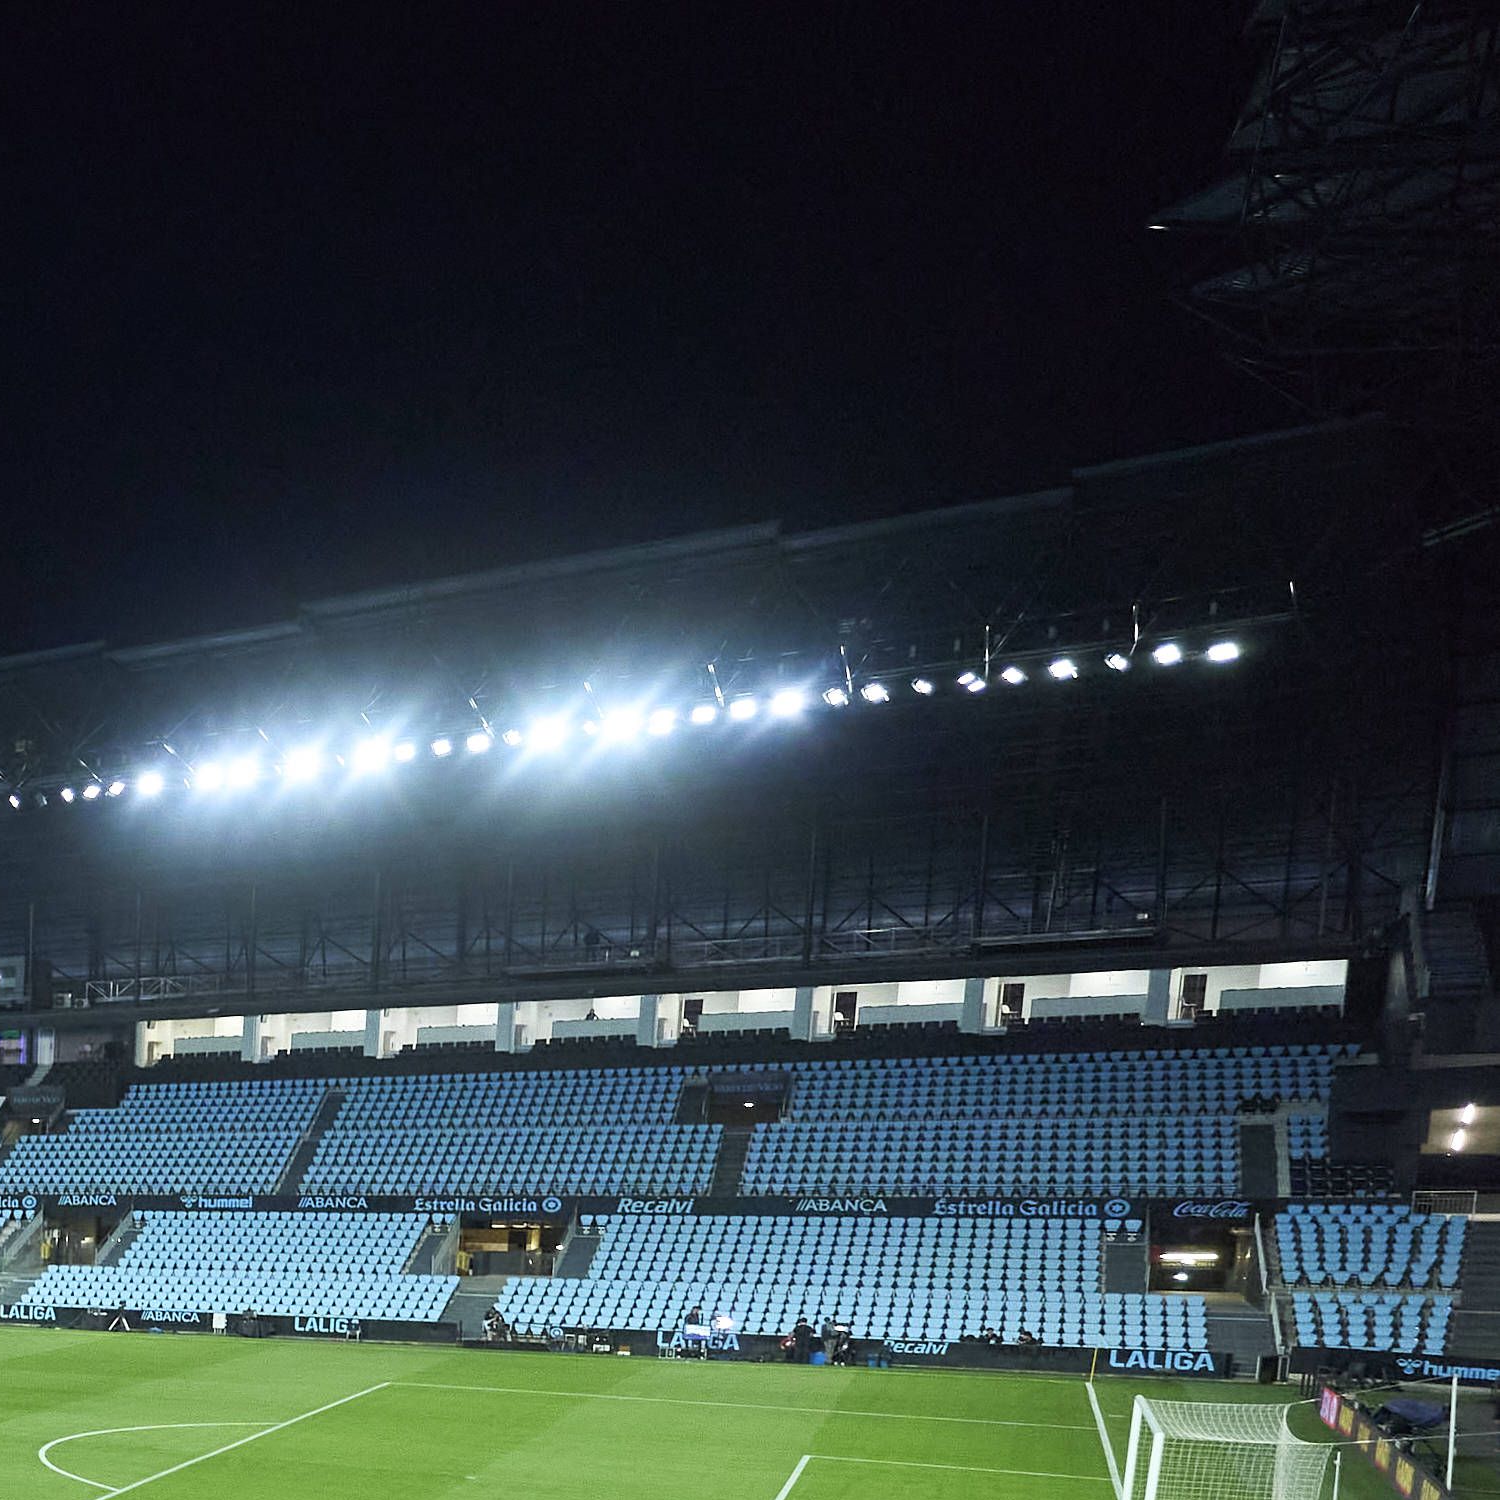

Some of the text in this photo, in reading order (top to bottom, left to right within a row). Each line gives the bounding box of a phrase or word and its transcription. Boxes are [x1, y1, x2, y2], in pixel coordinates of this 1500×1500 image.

[65, 1195, 117, 1206] ABANCA
[198, 1196, 253, 1208] hummel
[305, 1197, 368, 1208] ABANCA
[414, 1197, 537, 1215] Estrella Galicia
[617, 1198, 695, 1214] Recalvi
[806, 1199, 888, 1212] ABANCA
[933, 1199, 1098, 1217] Estrella Galicia
[0, 1304, 56, 1321] LALIGA
[147, 1311, 200, 1323] ABANCA
[294, 1316, 359, 1333] LALIG
[1108, 1349, 1215, 1372] LALIGA
[1423, 1359, 1500, 1381] humme
